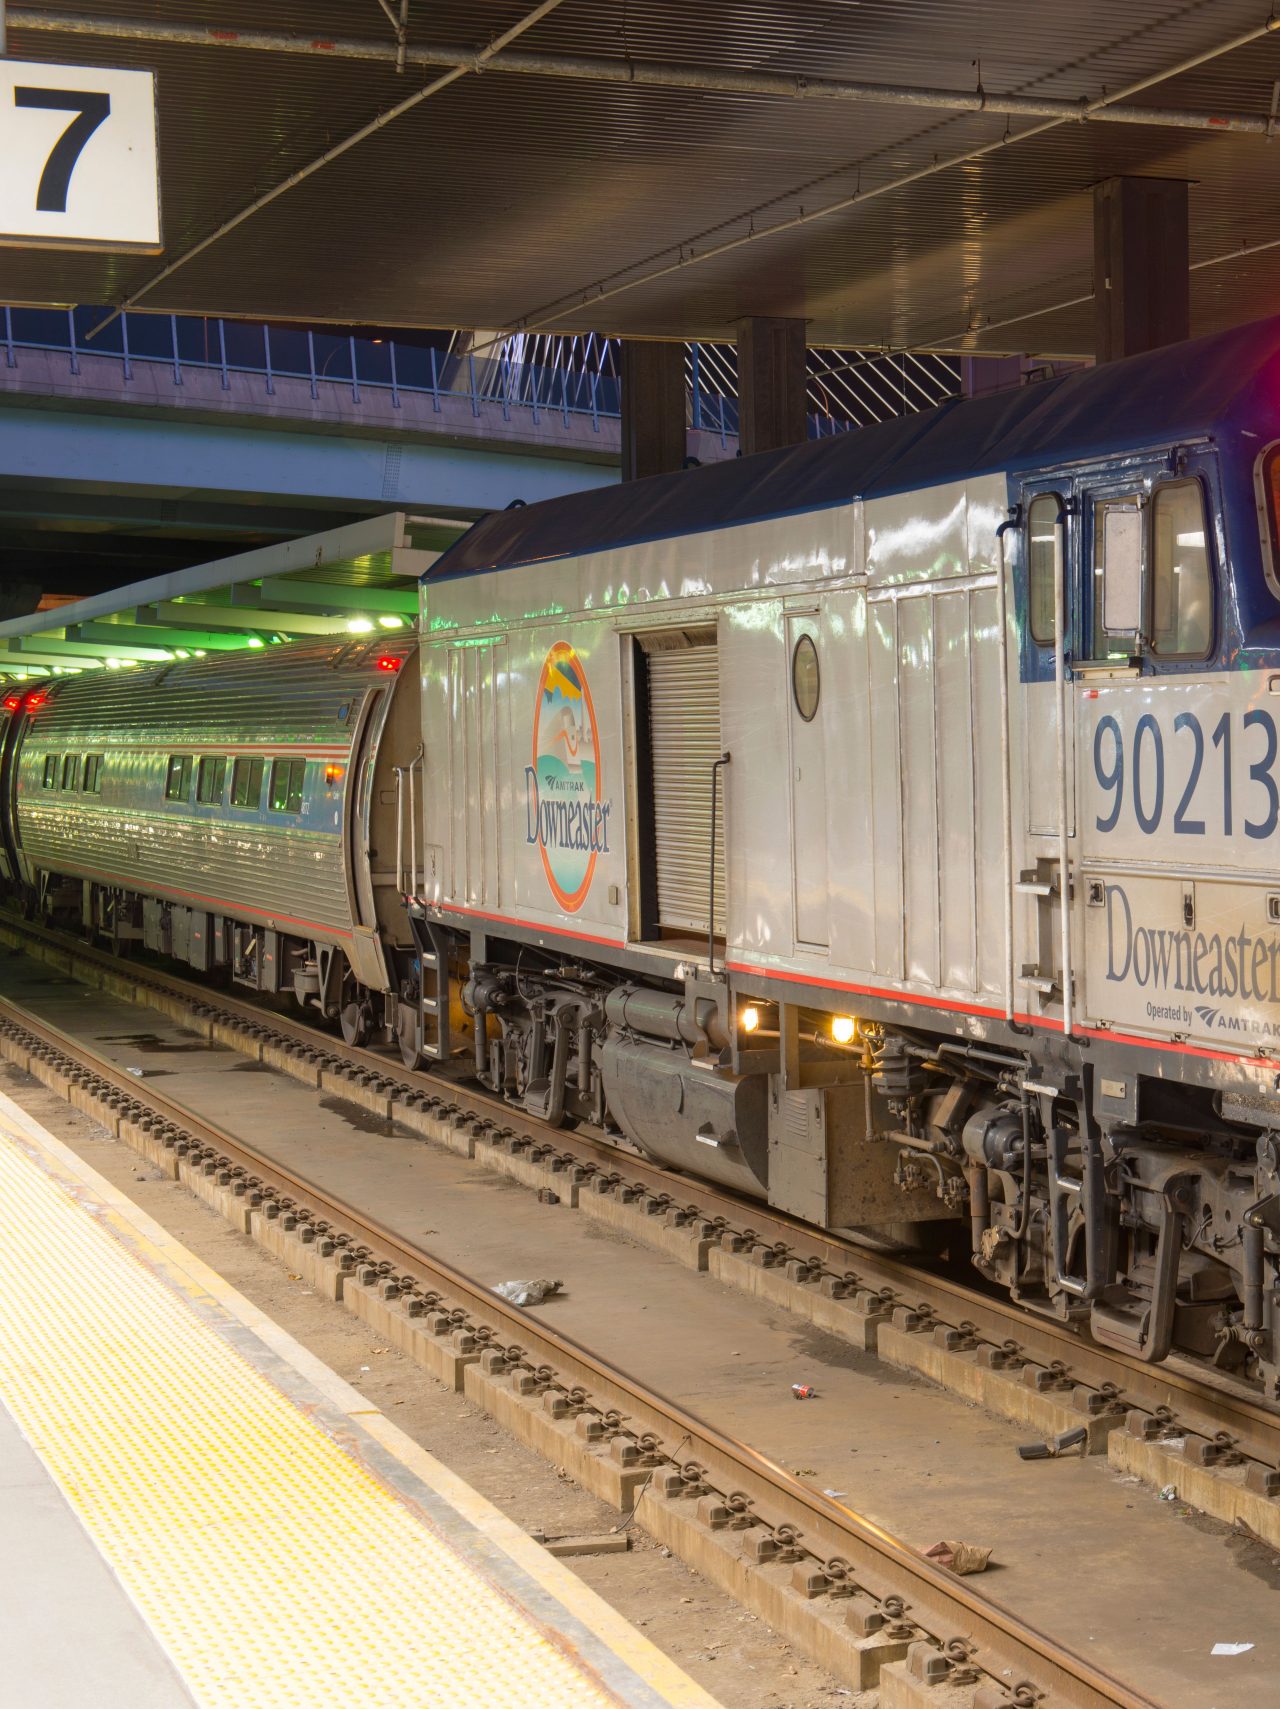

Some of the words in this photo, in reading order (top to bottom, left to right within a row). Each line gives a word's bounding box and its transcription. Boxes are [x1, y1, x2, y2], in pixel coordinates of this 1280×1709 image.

[15, 86, 111, 213] 7
[525, 766, 610, 853] Downeaster
[555, 780, 585, 792] AMTRAK
[1094, 708, 1280, 840] 90213
[1146, 1001, 1181, 1021] Operated
[1183, 1005, 1193, 1027] by
